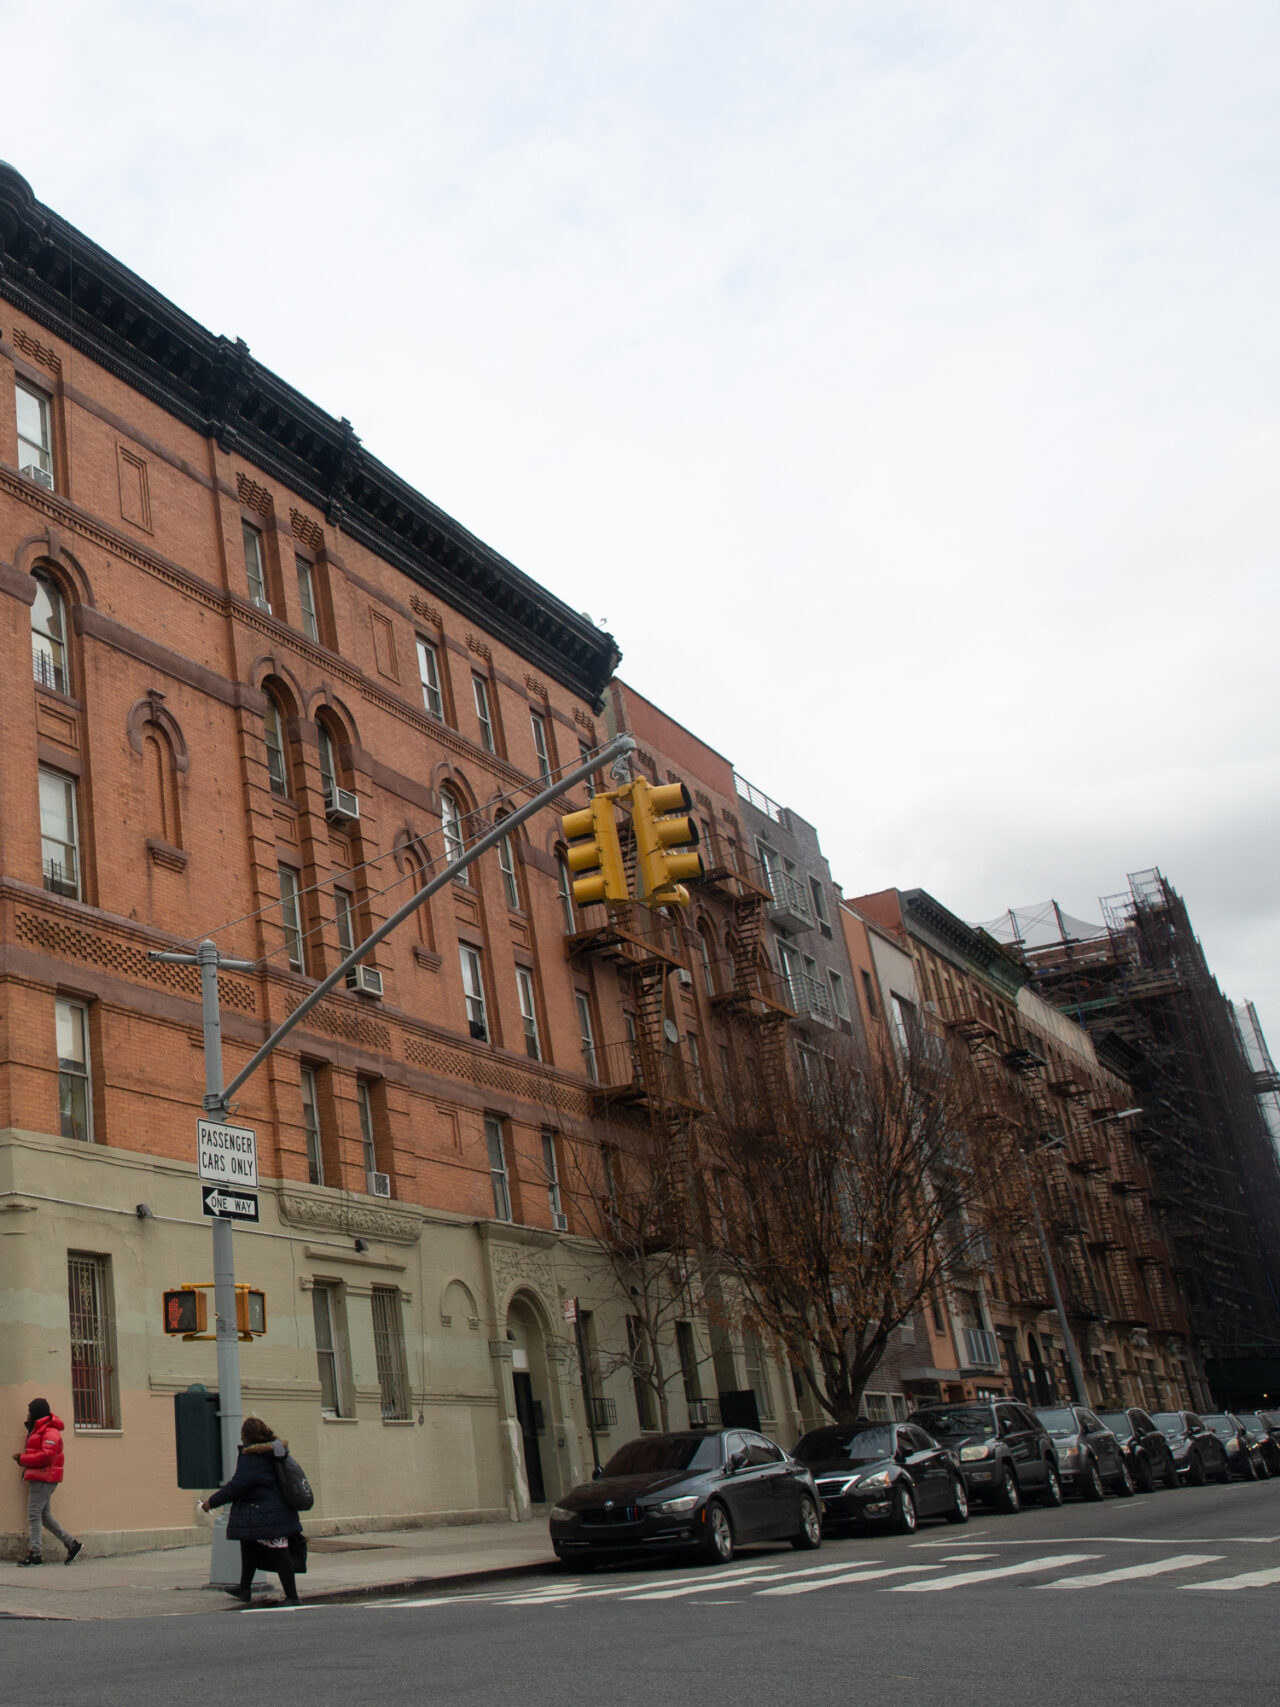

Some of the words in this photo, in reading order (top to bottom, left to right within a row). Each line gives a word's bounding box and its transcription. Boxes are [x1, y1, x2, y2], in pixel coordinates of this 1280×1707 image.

[201, 1128, 252, 1154] PASSENGER
[202, 1151, 225, 1172] CARS
[231, 1157, 253, 1177] ONLY
[211, 1196, 228, 1210] ONE
[234, 1200, 252, 1213] WAY
